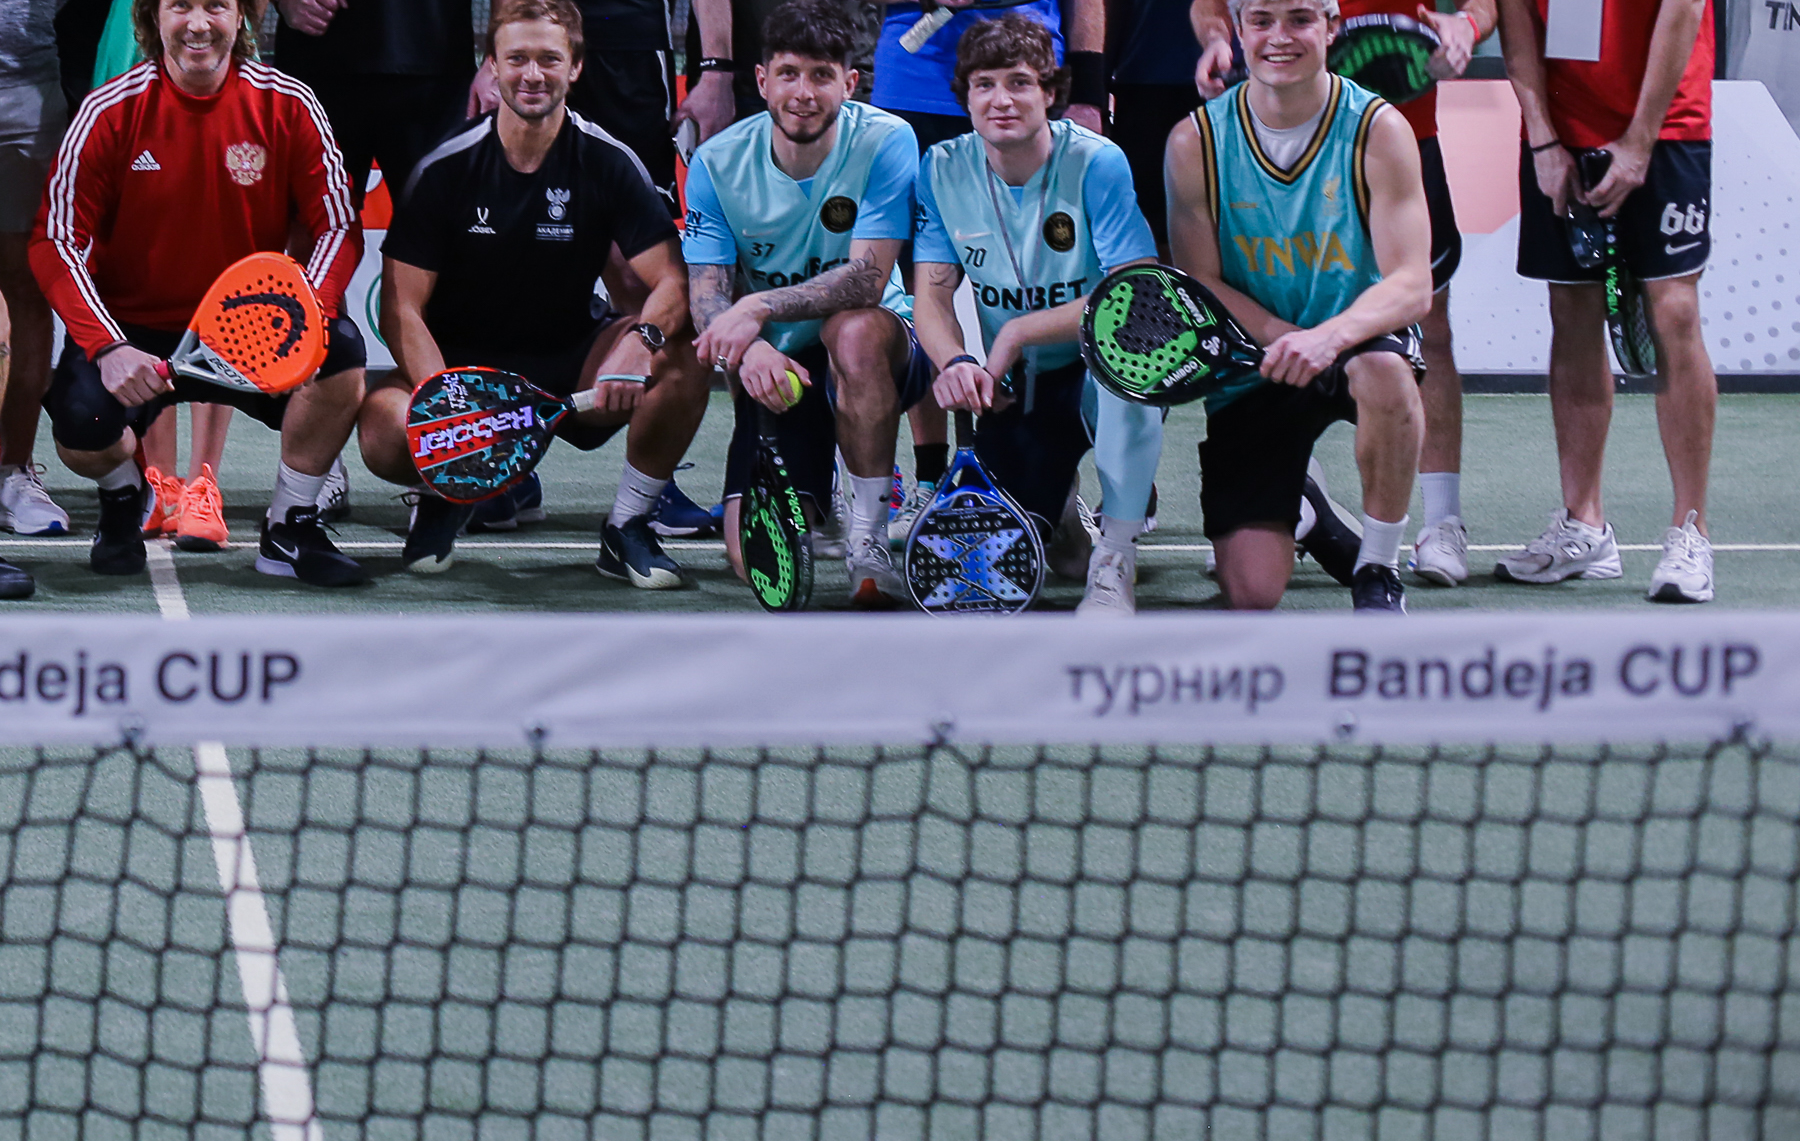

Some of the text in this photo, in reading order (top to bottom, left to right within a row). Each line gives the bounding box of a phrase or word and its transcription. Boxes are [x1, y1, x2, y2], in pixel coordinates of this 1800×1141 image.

[131, 163, 162, 171] adidas
[750, 242, 776, 258] 37
[964, 245, 988, 268] 70
[1233, 231, 1356, 277] YNWA
[208, 356, 249, 386] DELTA
[1162, 360, 1199, 388] BAMBOO
[784, 485, 807, 537] VIBOR-A
[155, 651, 302, 704] CUP
[1067, 643, 1761, 716] турнир Bandeja CUP
